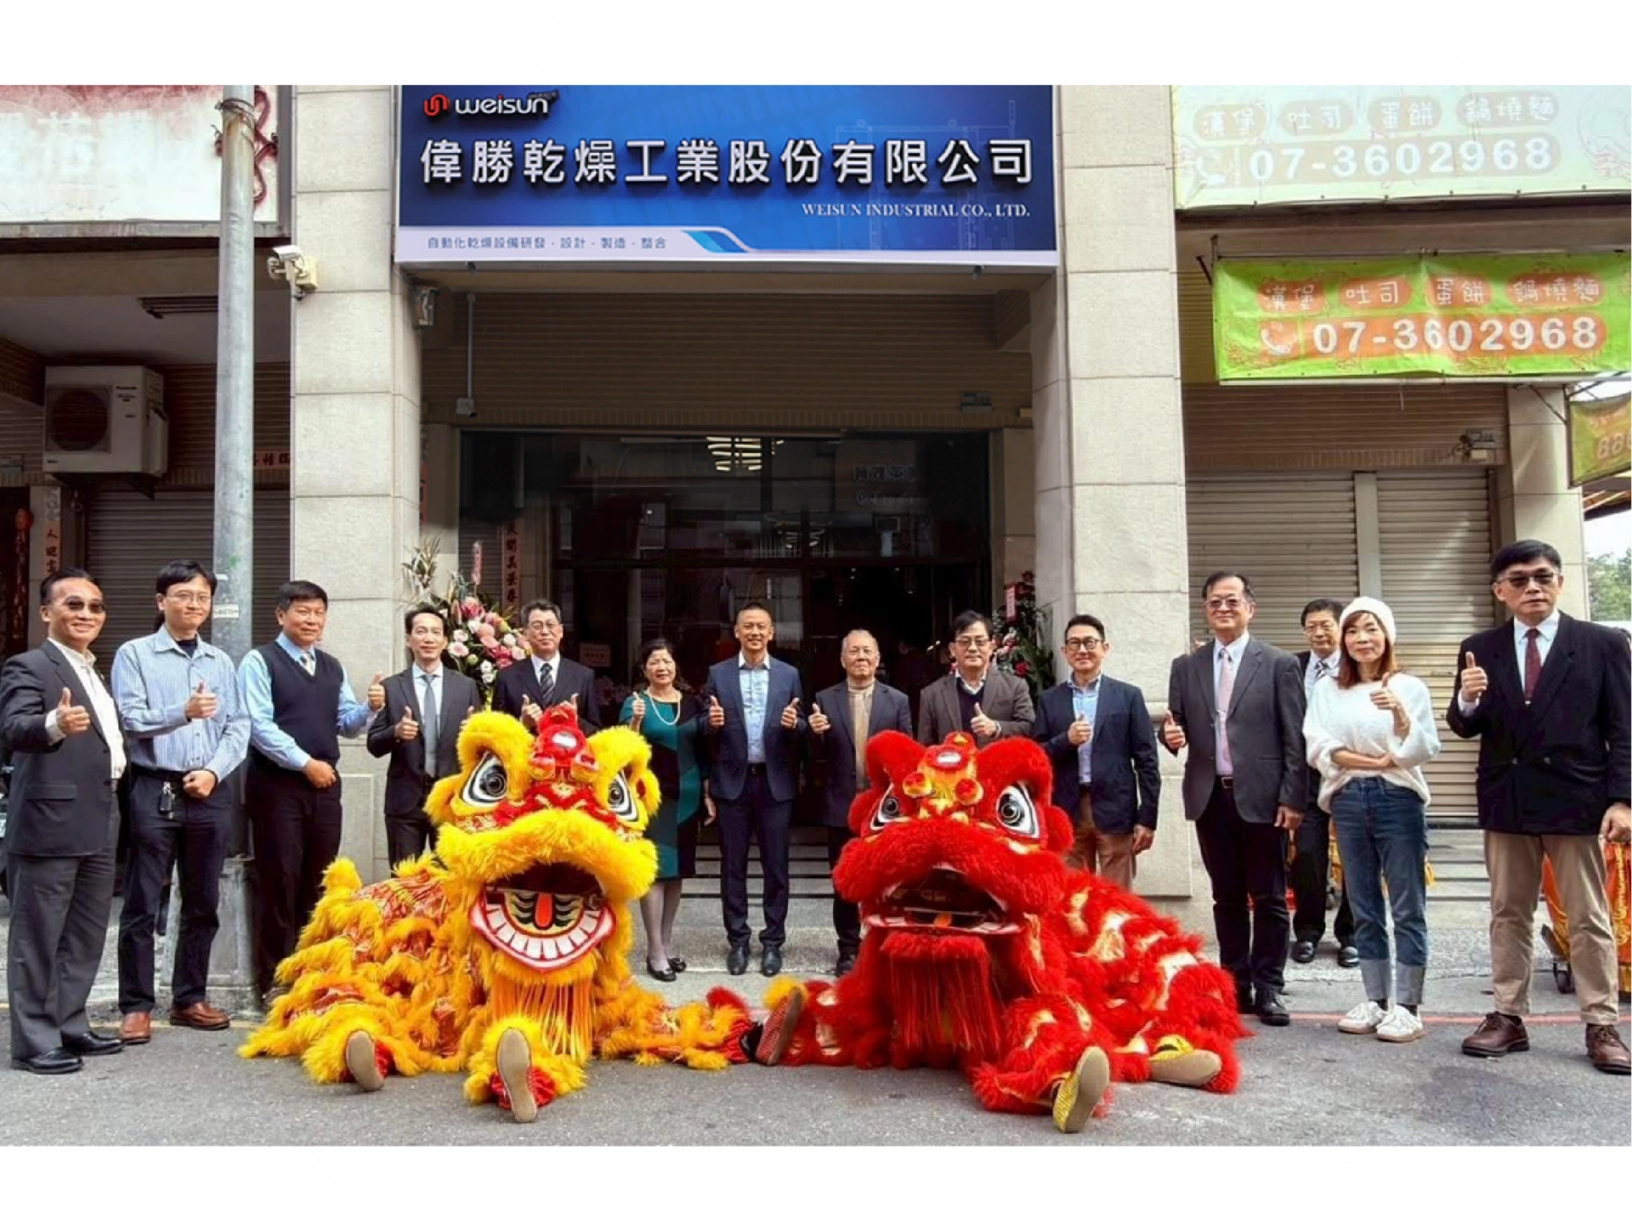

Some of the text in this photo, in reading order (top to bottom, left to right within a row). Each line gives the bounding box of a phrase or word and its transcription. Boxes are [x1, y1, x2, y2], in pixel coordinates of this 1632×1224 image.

[455, 94, 548, 114] weisun
[1288, 105, 1340, 131] 吐司
[420, 139, 1032, 184] 偉勝乾燥工業股份有限公司
[1248, 136, 1552, 183] 07-3602968
[802, 203, 1031, 218] WEISUN INDUSTRIAL CO., LTD.
[1345, 281, 1398, 305] 吐司
[1312, 315, 1598, 355] 07-3602968
